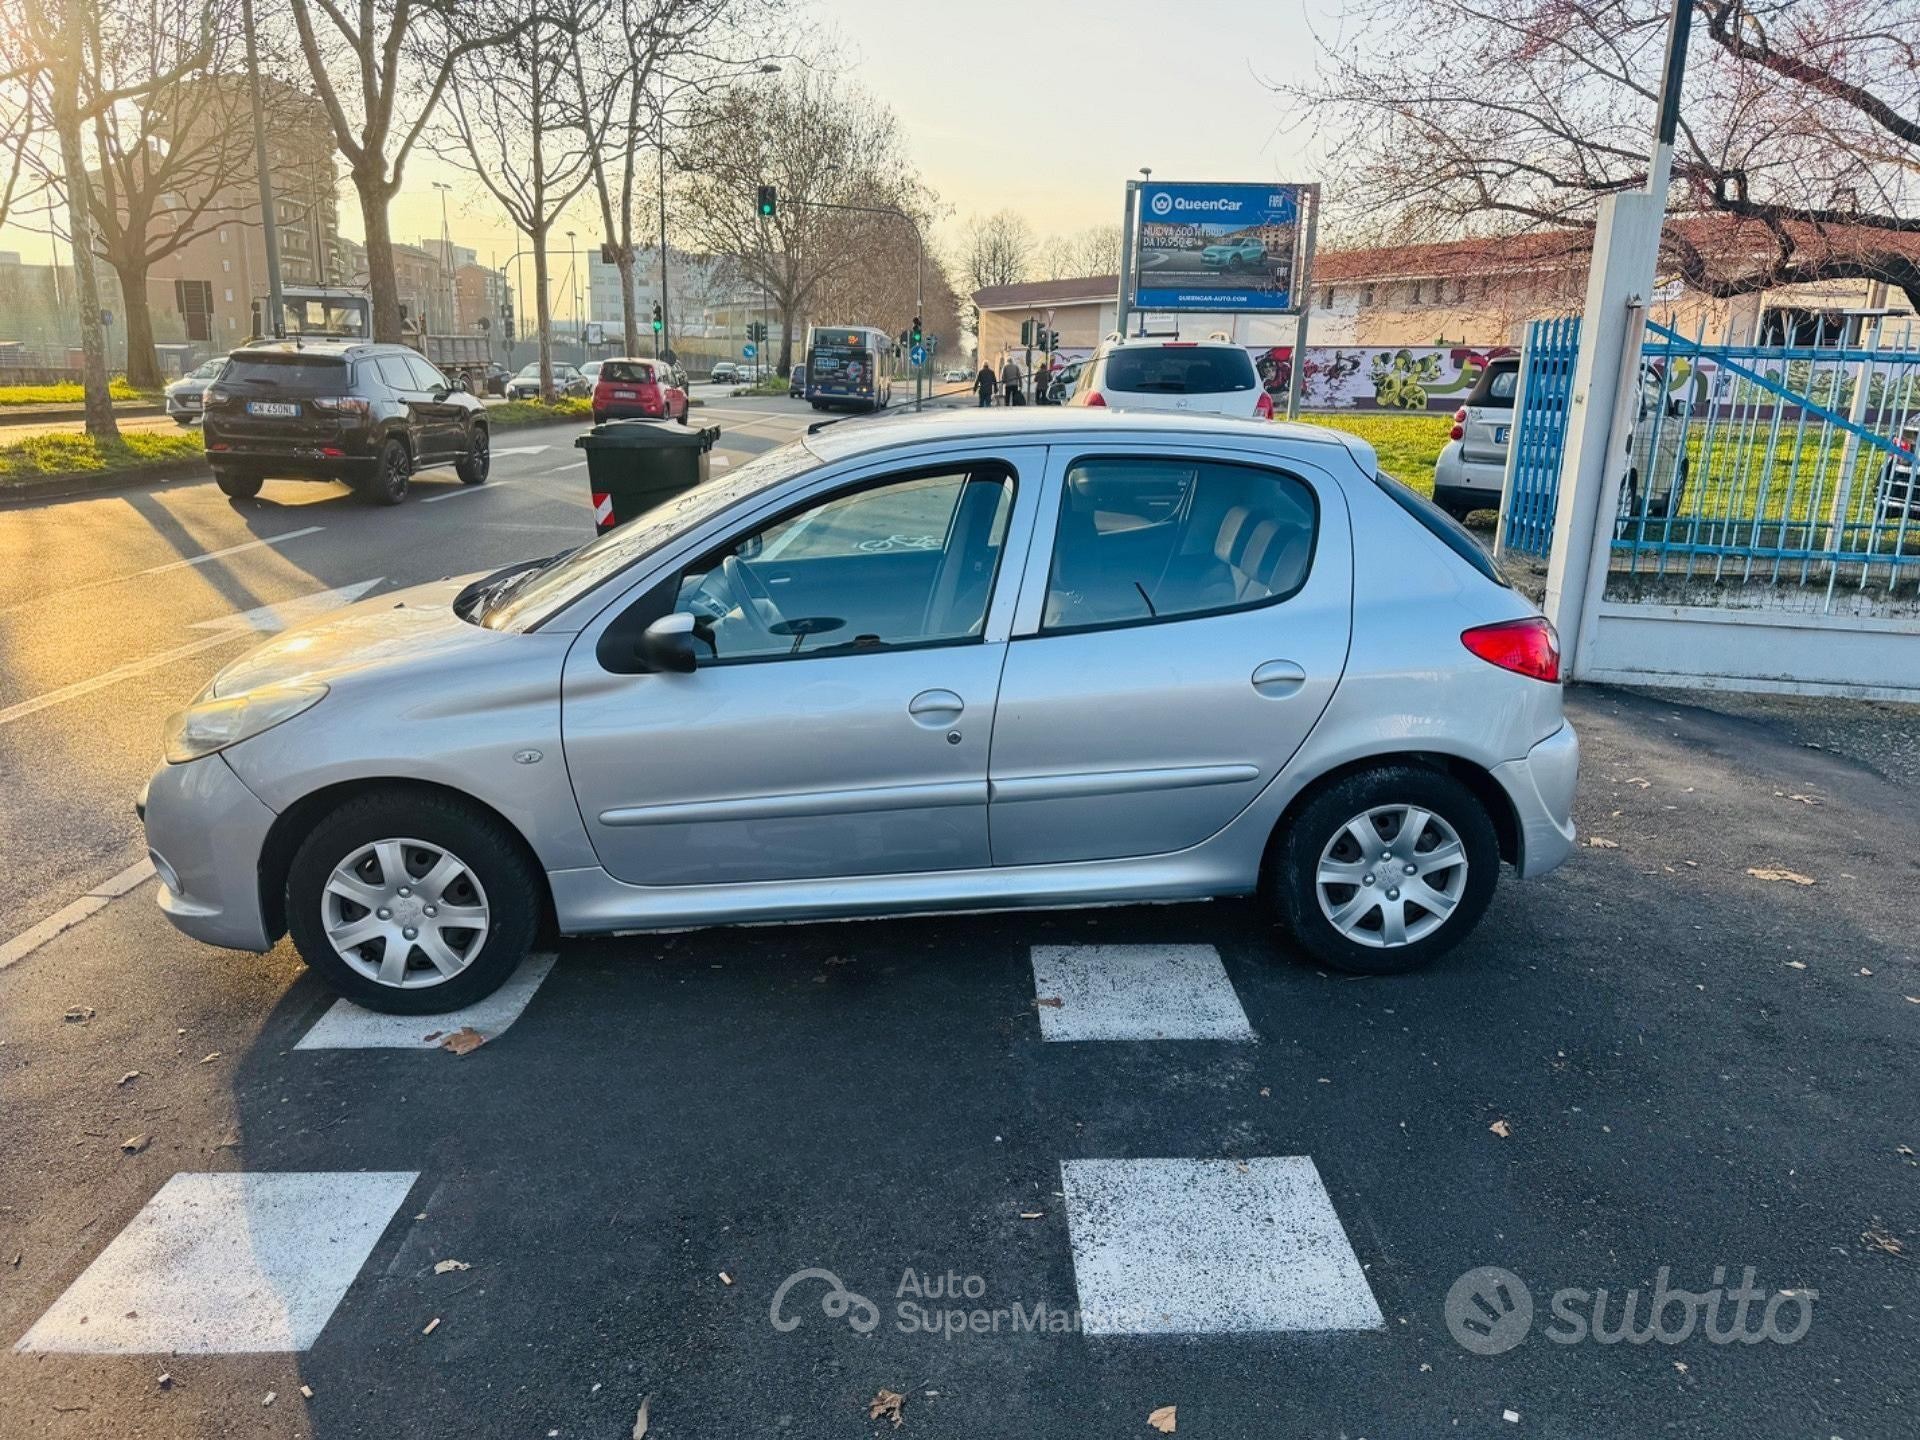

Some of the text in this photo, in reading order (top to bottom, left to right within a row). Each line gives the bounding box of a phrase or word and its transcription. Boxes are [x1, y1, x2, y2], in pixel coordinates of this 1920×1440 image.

[1174, 197, 1243, 212] QueenCar
[1143, 227, 1175, 237] NUOVA
[1177, 226, 1194, 237] 600
[1178, 295, 1248, 303] QUEENCAR-AUTO.COM
